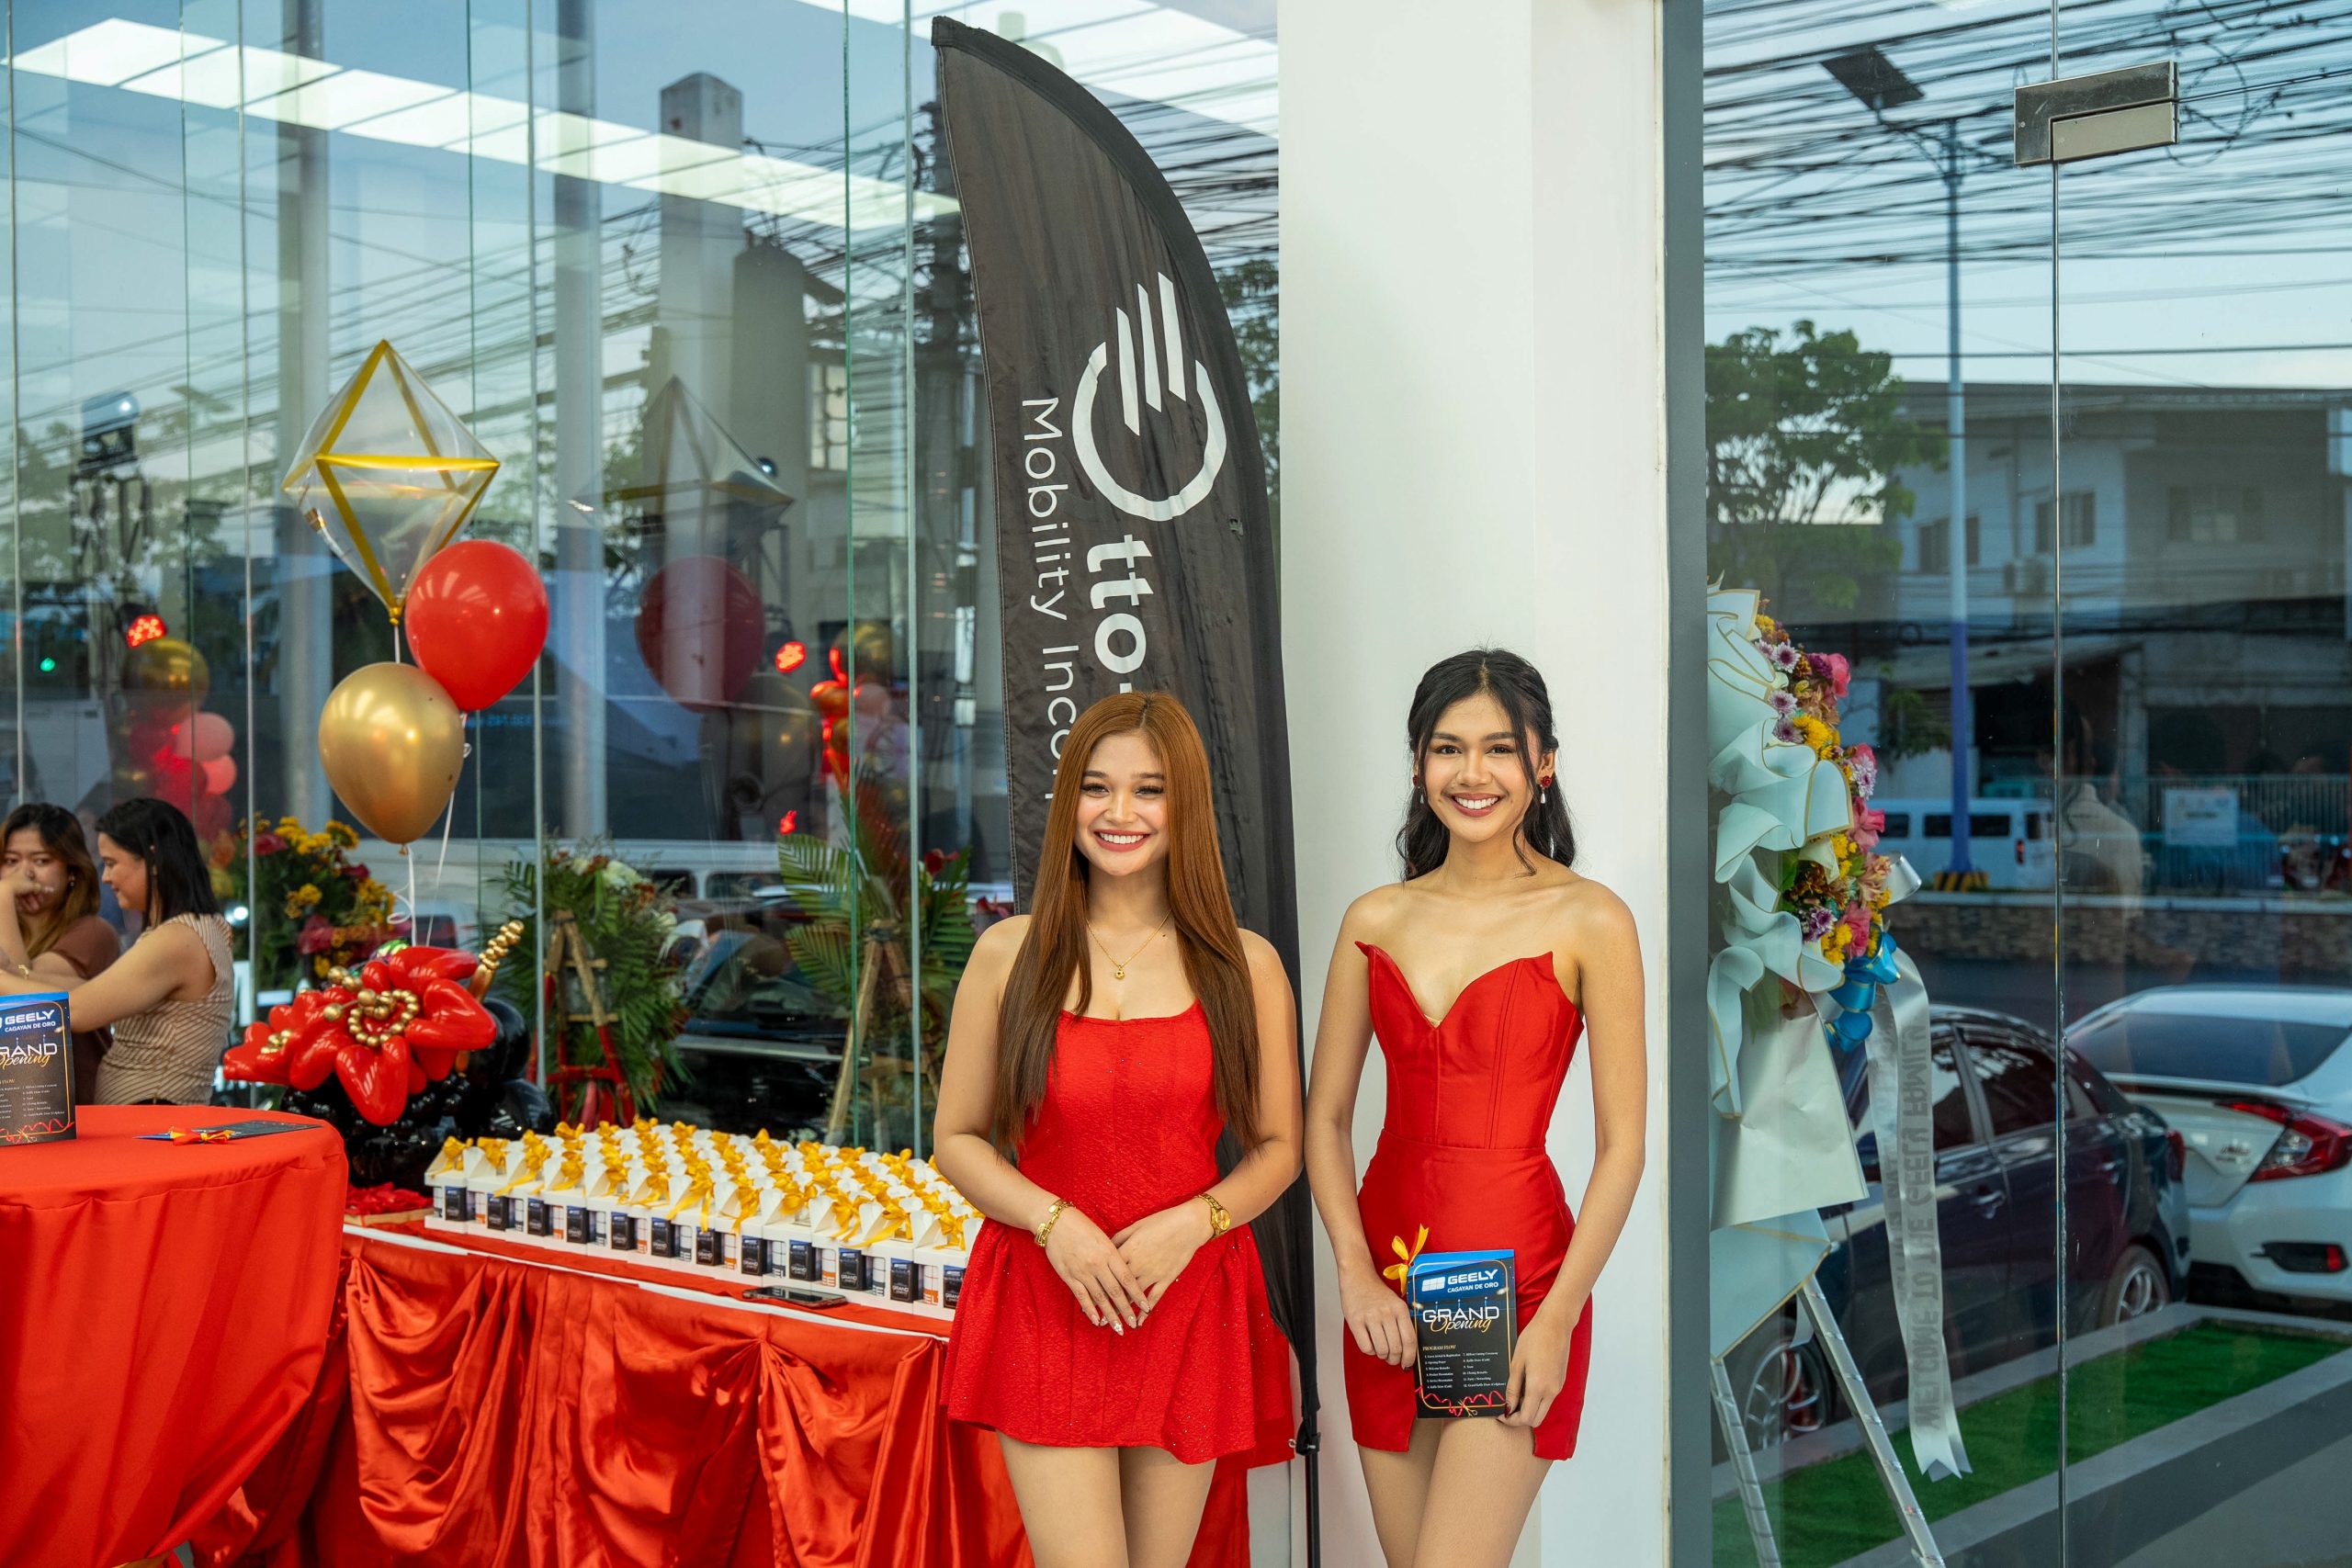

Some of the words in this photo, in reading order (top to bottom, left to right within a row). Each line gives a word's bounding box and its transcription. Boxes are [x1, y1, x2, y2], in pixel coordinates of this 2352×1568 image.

[1022, 397, 1070, 621] Mobility
[5, 1010, 55, 1025] GEELY
[5, 1024, 32, 1032] CAGAYAN
[0, 1043, 58, 1058] RAND
[1447, 1269, 1498, 1285] GEELY
[1447, 1285, 1474, 1293] CAGAYAN
[1422, 1305, 1500, 1323] GRAND
[1430, 1315, 1492, 1335] Opening
